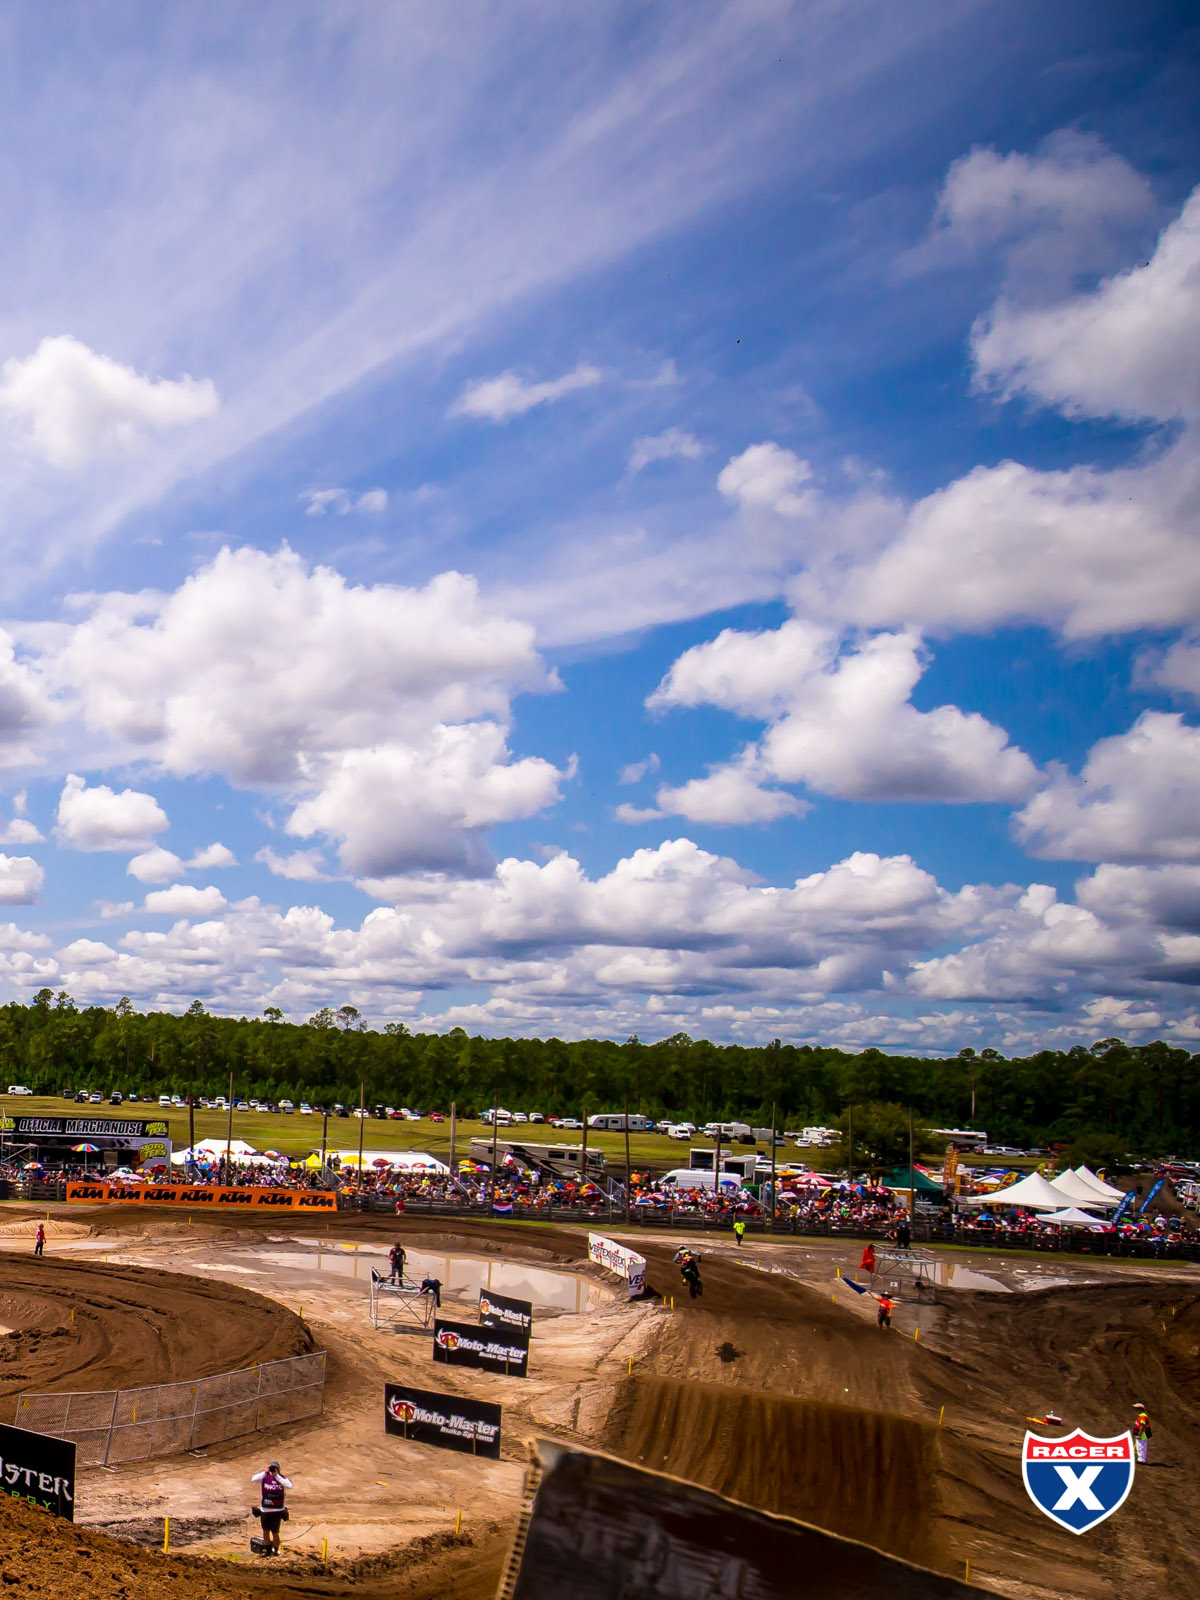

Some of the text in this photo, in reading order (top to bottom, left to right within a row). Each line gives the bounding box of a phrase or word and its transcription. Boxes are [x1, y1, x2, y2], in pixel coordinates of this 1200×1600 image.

[18, 1119, 143, 1135] OFFICIAL MERCHANDISE
[69, 1186, 334, 1208] KTM KTM KTM KTM KTM KTM KTM
[589, 1242, 611, 1258] VERTEX
